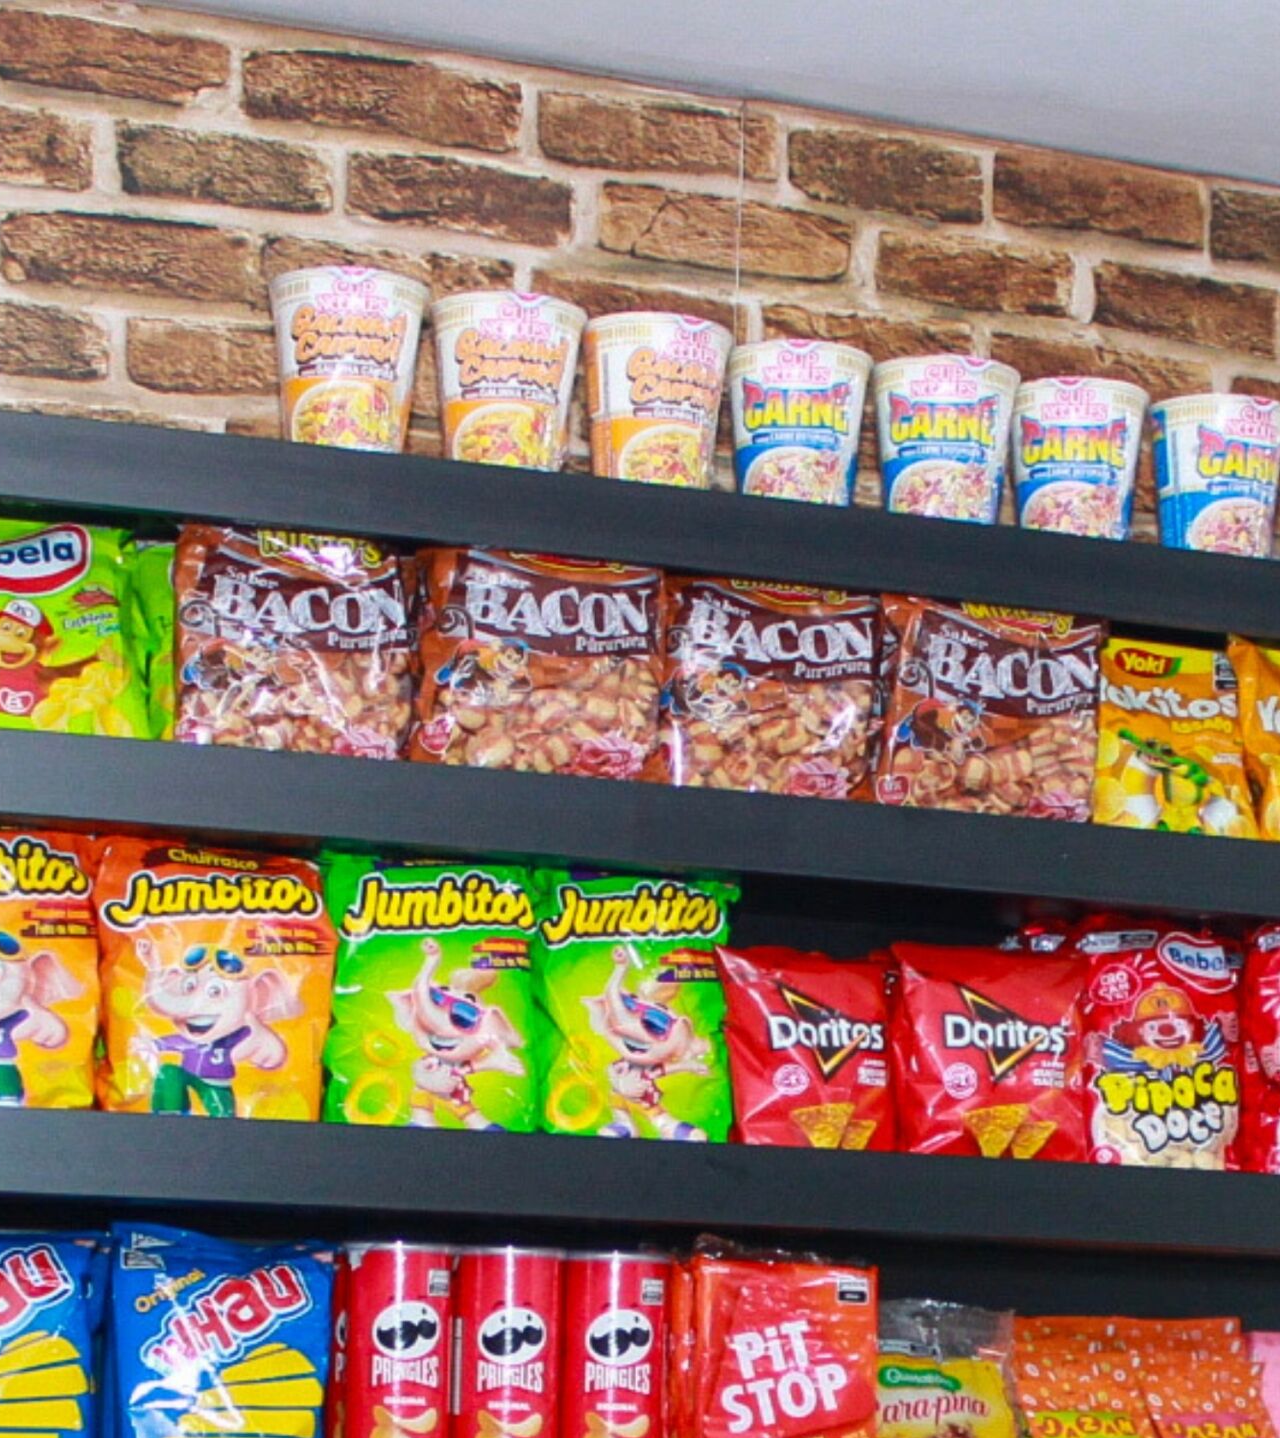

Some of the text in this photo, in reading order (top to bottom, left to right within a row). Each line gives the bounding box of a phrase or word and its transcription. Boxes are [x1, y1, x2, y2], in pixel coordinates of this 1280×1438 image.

[742, 377, 852, 435] CARNE
[888, 391, 999, 450] CARNE
[1020, 416, 1129, 471] CARNE
[213, 573, 408, 637] BACON
[469, 576, 653, 640] BACON
[690, 597, 875, 667] BACON
[925, 630, 1102, 702] BACON
[1122, 650, 1168, 676] Yoki
[106, 875, 322, 926] Jumbitos
[342, 874, 537, 936] Jumbitos
[541, 884, 721, 945] Jumbitos
[770, 1013, 887, 1053] Doritos
[943, 1013, 1068, 1055] Doritos
[372, 1355, 440, 1388] PRINGLES
[477, 1360, 545, 1393] PRINGLES
[585, 1361, 652, 1394] PRINGLES
[722, 1363, 848, 1435] STOP
